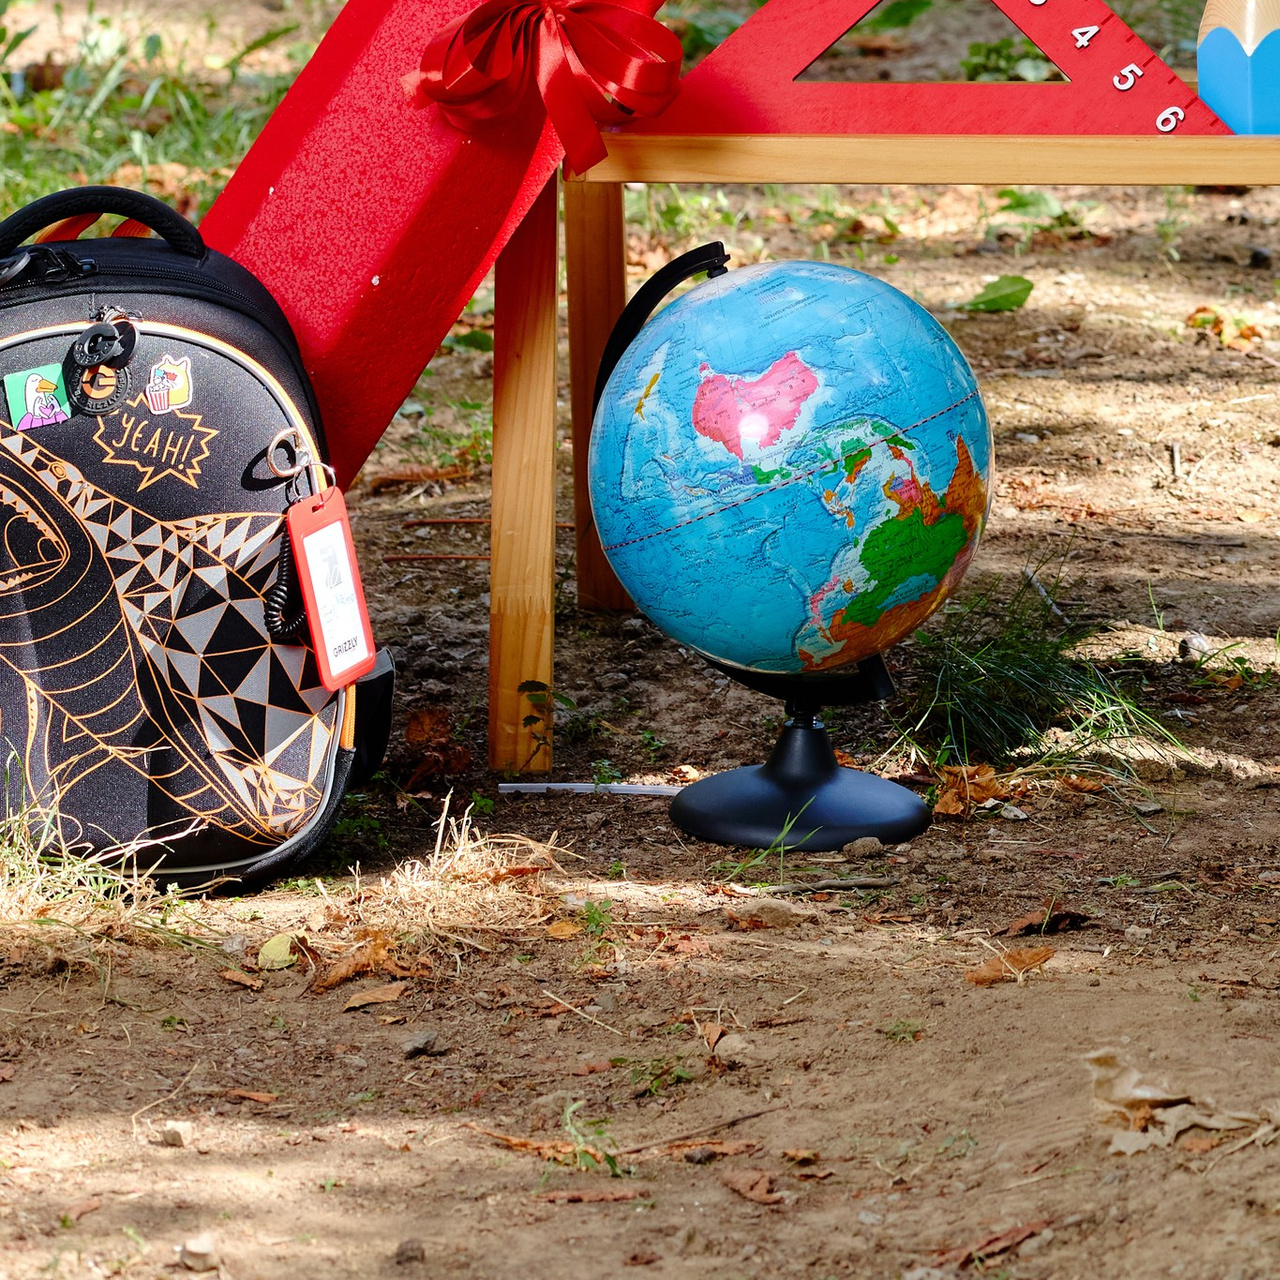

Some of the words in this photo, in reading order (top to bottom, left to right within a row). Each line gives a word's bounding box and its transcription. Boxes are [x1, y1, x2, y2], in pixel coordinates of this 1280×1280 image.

[1071, 24, 1100, 50] 4
[1113, 62, 1144, 91] 5
[1155, 105, 1185, 133] 6
[112, 413, 195, 470] YEAH!
[333, 636, 358, 658] GRIZZLY
